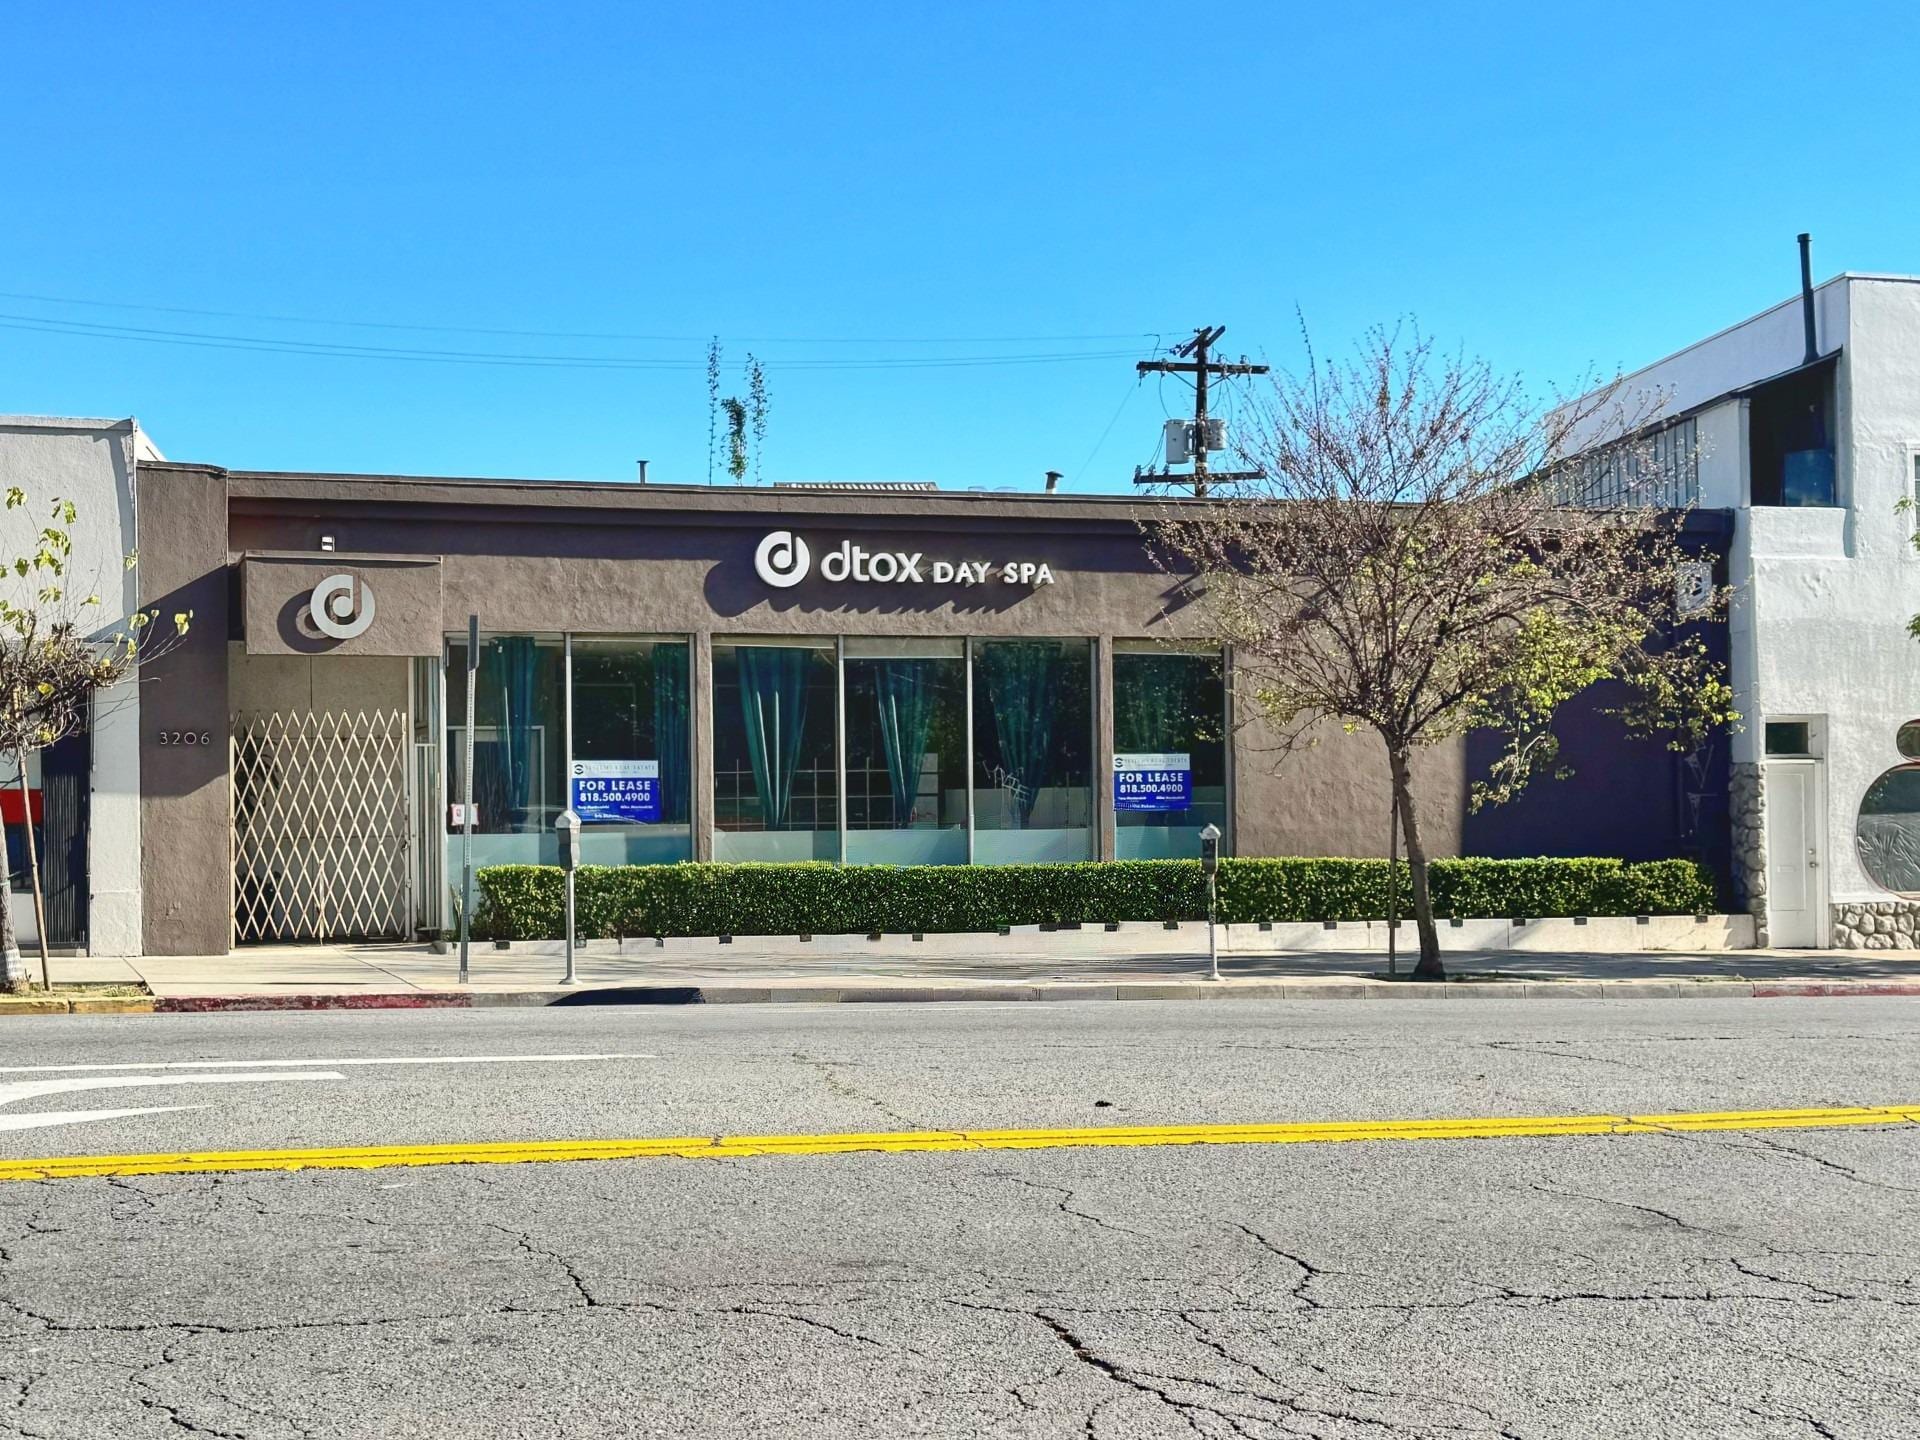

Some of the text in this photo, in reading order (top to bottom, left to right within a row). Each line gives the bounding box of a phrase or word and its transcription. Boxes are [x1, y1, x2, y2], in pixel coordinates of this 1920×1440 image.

[821, 540, 1054, 584] dtox DAY SPA
[160, 732, 210, 745] 3206
[1119, 773, 1183, 782] FOR LEASE
[579, 781, 651, 791] FOR LEASE
[1120, 785, 1183, 793] 818.500.4900
[580, 793, 650, 802] 818.500.4900
